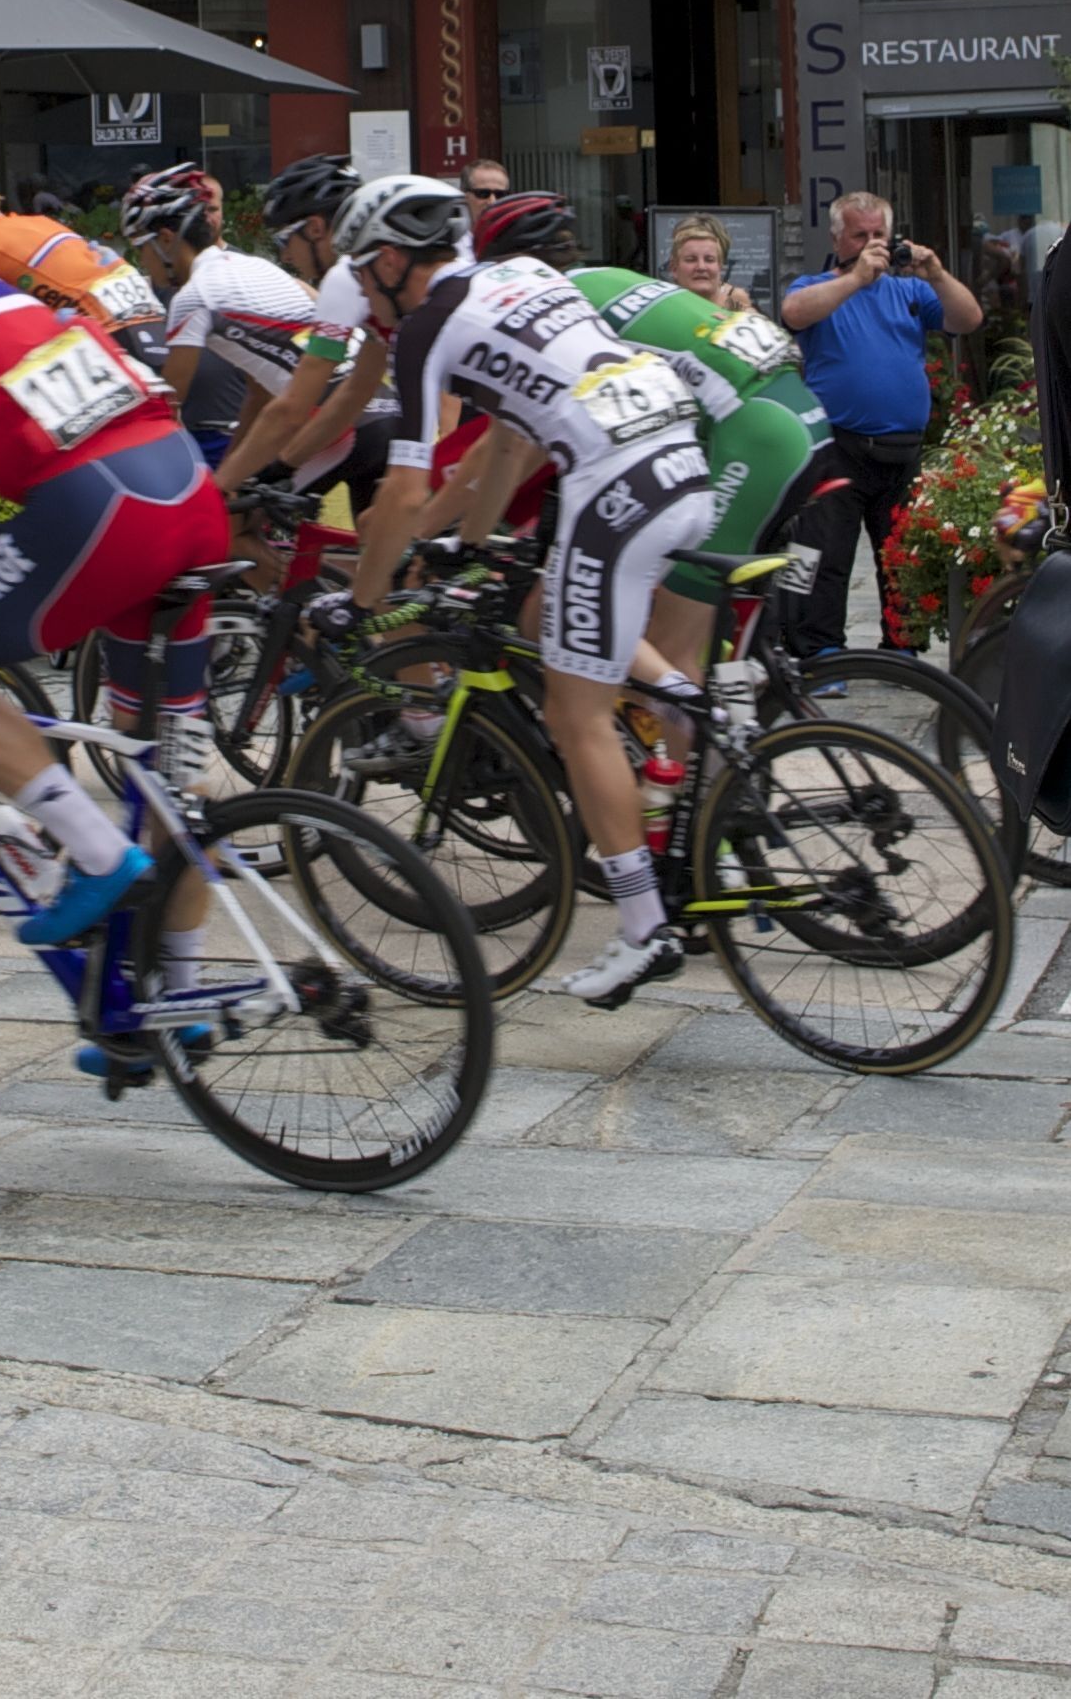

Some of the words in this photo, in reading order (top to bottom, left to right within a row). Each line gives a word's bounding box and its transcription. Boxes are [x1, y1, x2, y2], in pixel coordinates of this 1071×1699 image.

[861, 35, 1061, 67] RESTAURANT
[446, 136, 467, 156] H
[26, 349, 112, 417] 174
